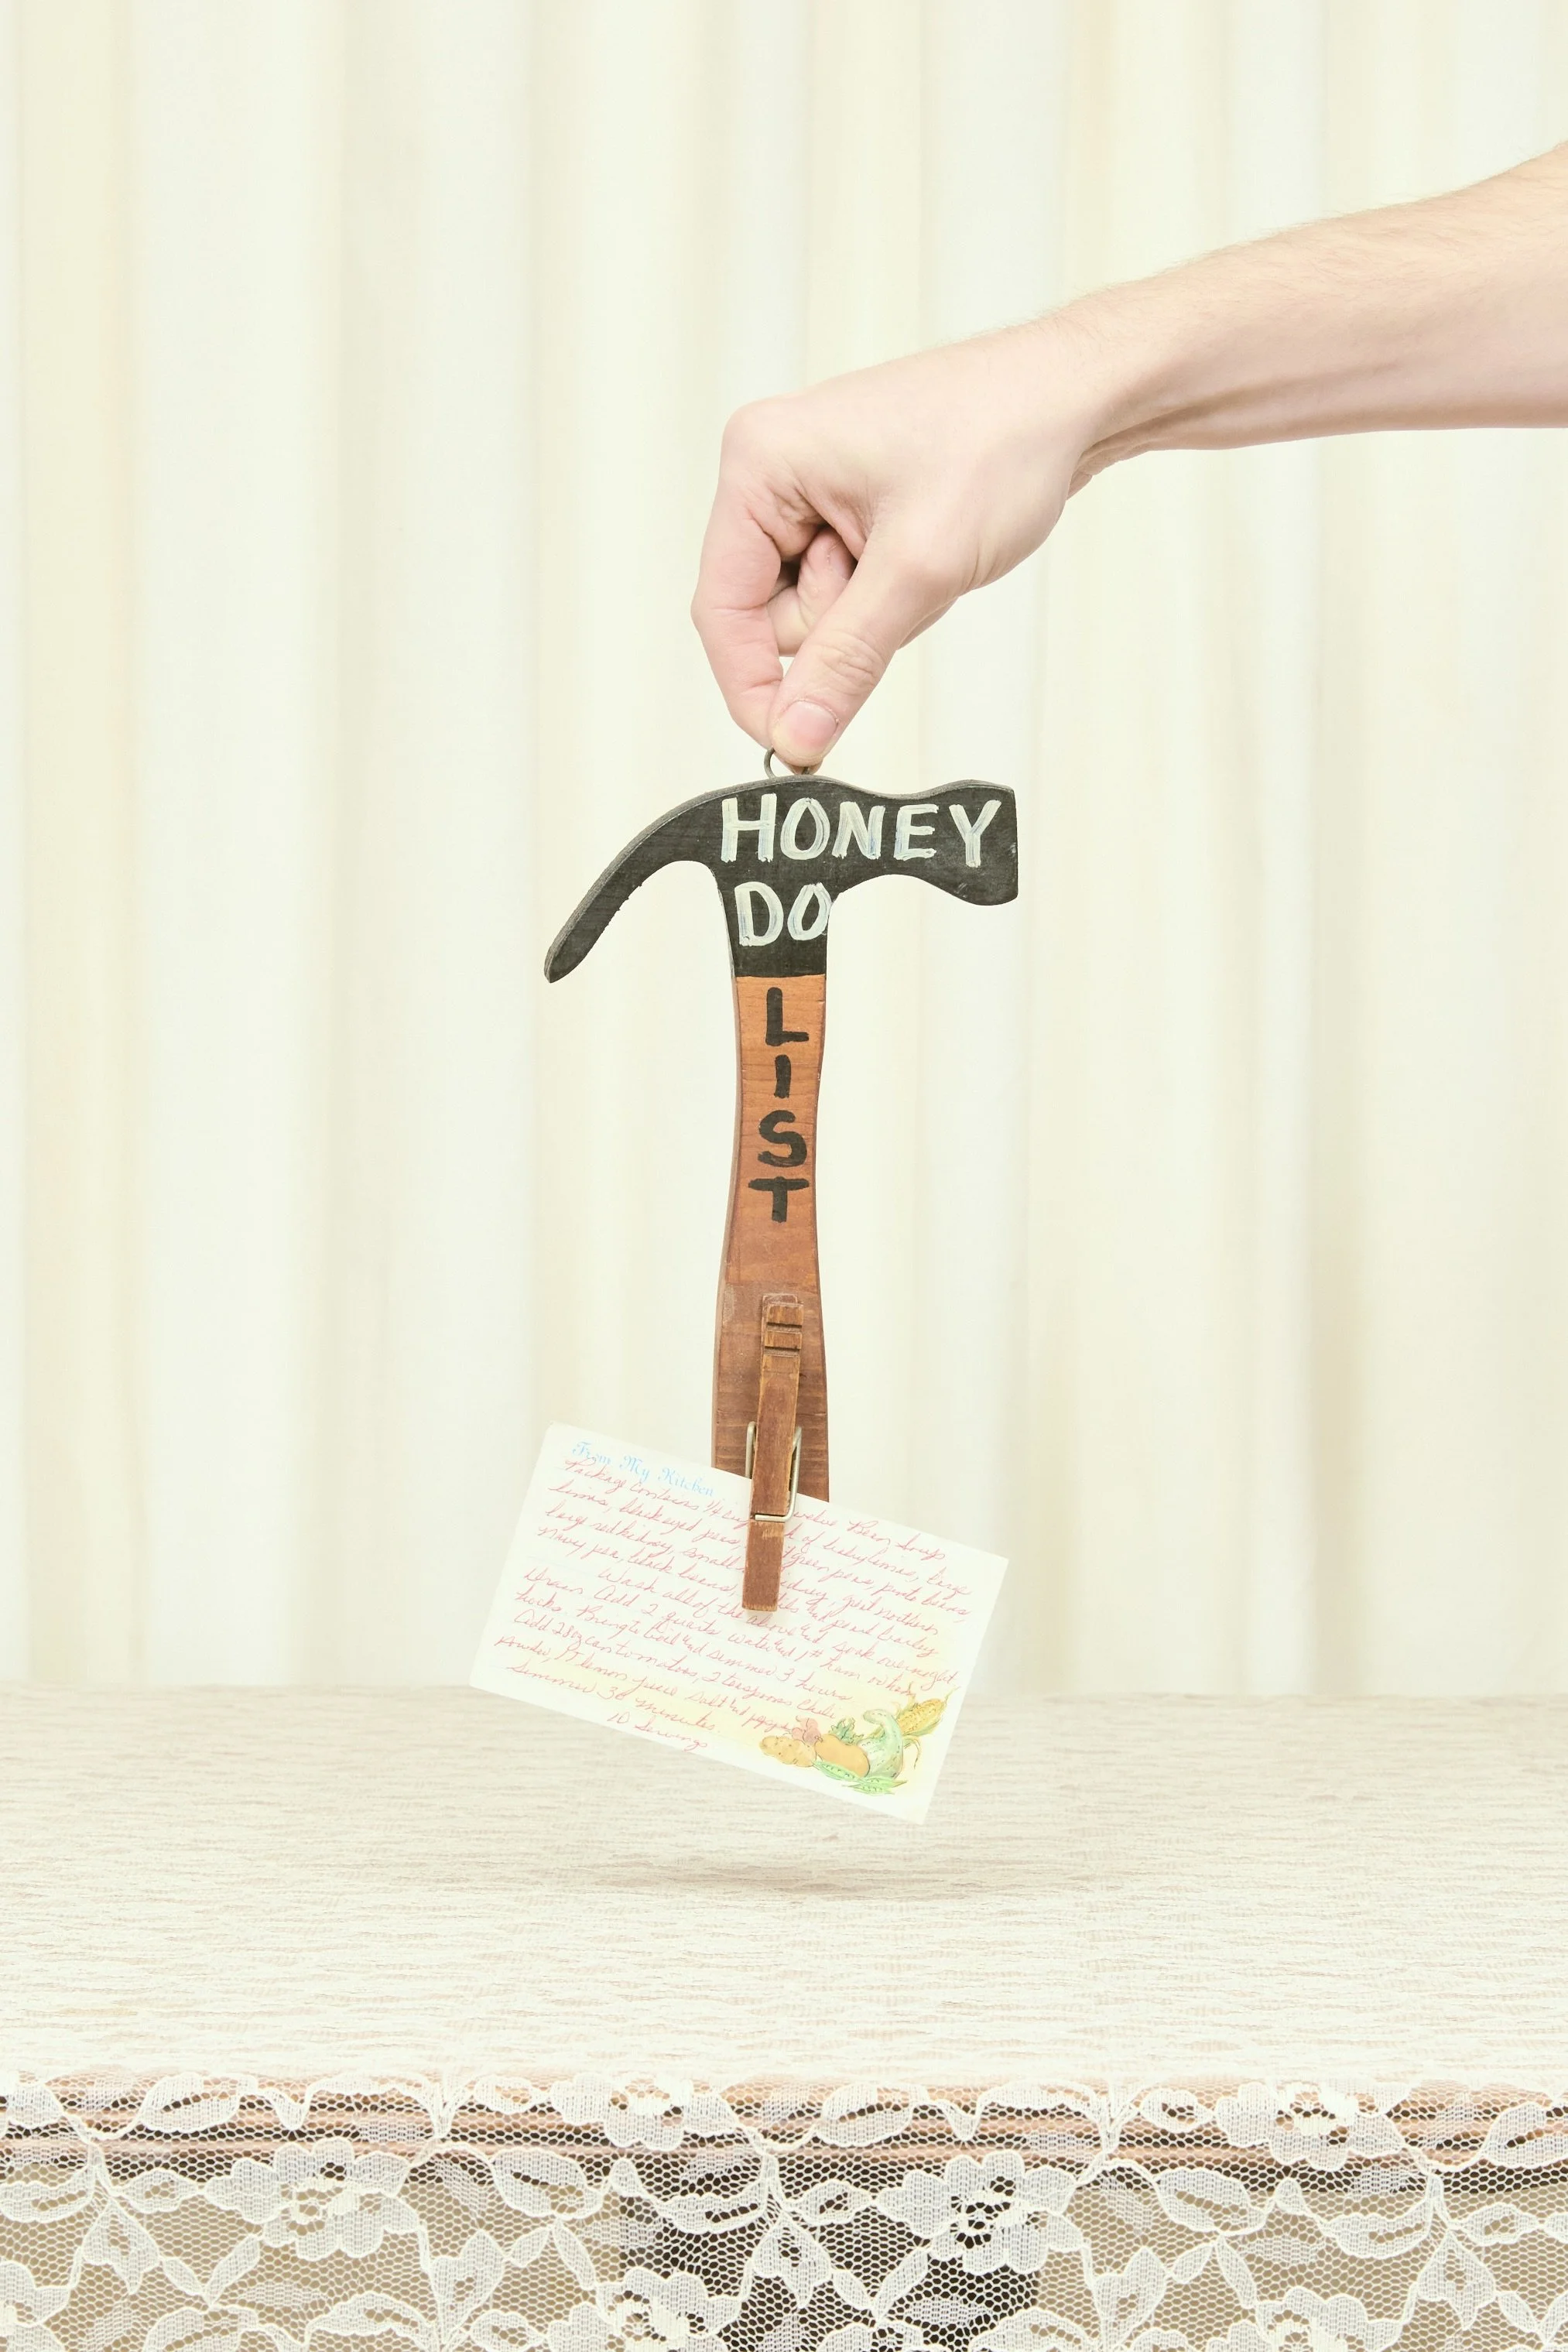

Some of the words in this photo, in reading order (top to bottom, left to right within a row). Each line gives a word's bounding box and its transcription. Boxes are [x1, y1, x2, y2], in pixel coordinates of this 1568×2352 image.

[721, 793, 1001, 868] HONEY
[734, 881, 832, 947] DO
[748, 987, 810, 1224] LIST
[572, 1441, 611, 1465] From
[618, 1456, 650, 1482] My
[662, 1467, 714, 1497] Kitchen
[642, 1603, 659, 1617] 2
[701, 1671, 721, 1683] 2
[777, 1668, 796, 1682] 3
